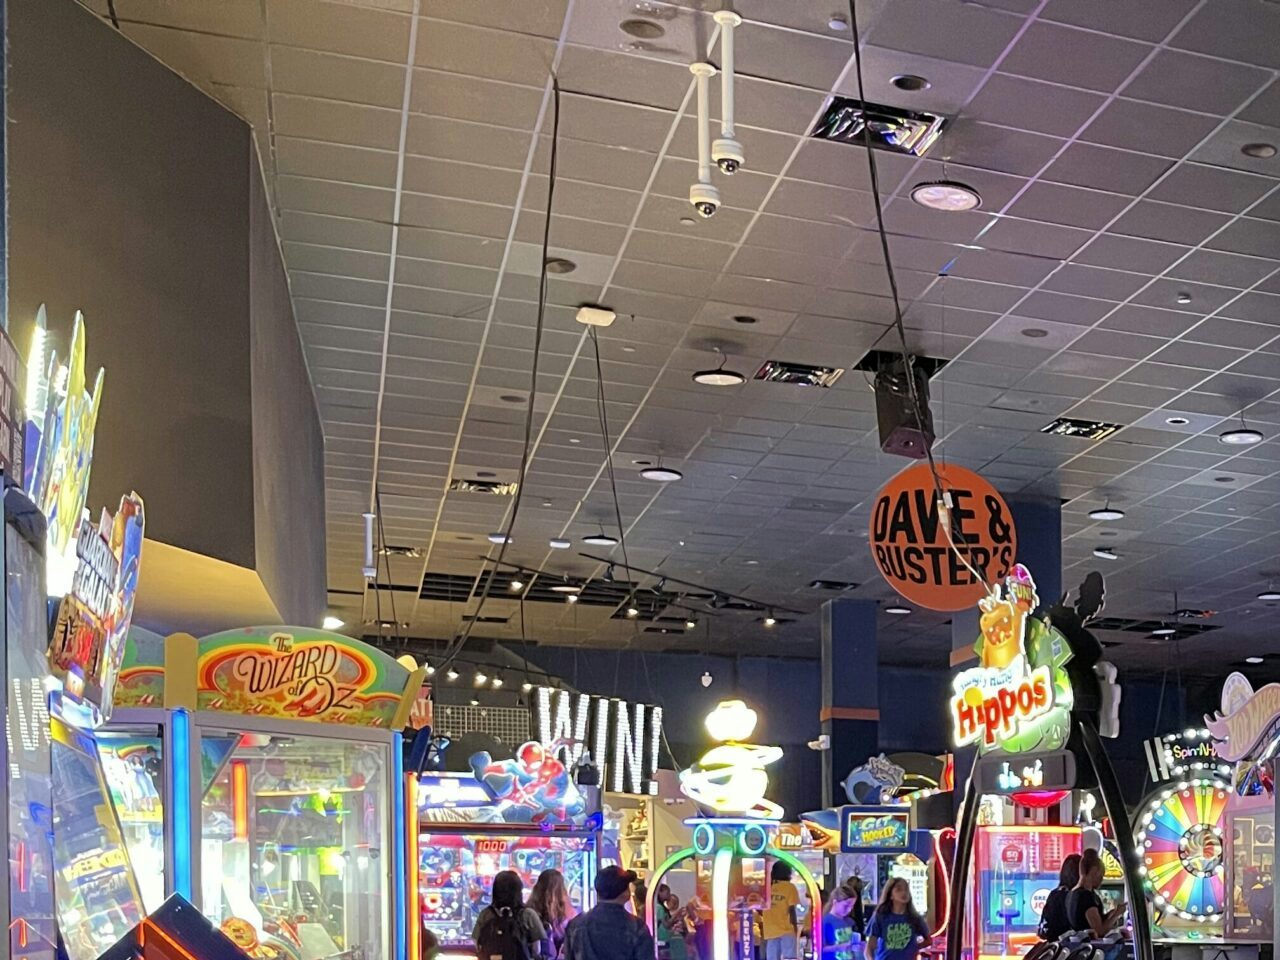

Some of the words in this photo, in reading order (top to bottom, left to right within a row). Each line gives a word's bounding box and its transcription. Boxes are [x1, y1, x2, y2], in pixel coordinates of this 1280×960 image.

[874, 489, 980, 544] DAVE
[985, 495, 1012, 544] &
[875, 545, 1012, 586] BUSTER'S
[273, 637, 292, 653] The
[238, 645, 337, 694] WIZARD
[288, 683, 301, 696] of
[956, 676, 1047, 745] Hippos
[538, 687, 663, 796] WIN!
[861, 815, 891, 830] GET
[478, 841, 507, 852] 1000
[782, 833, 802, 846] The
